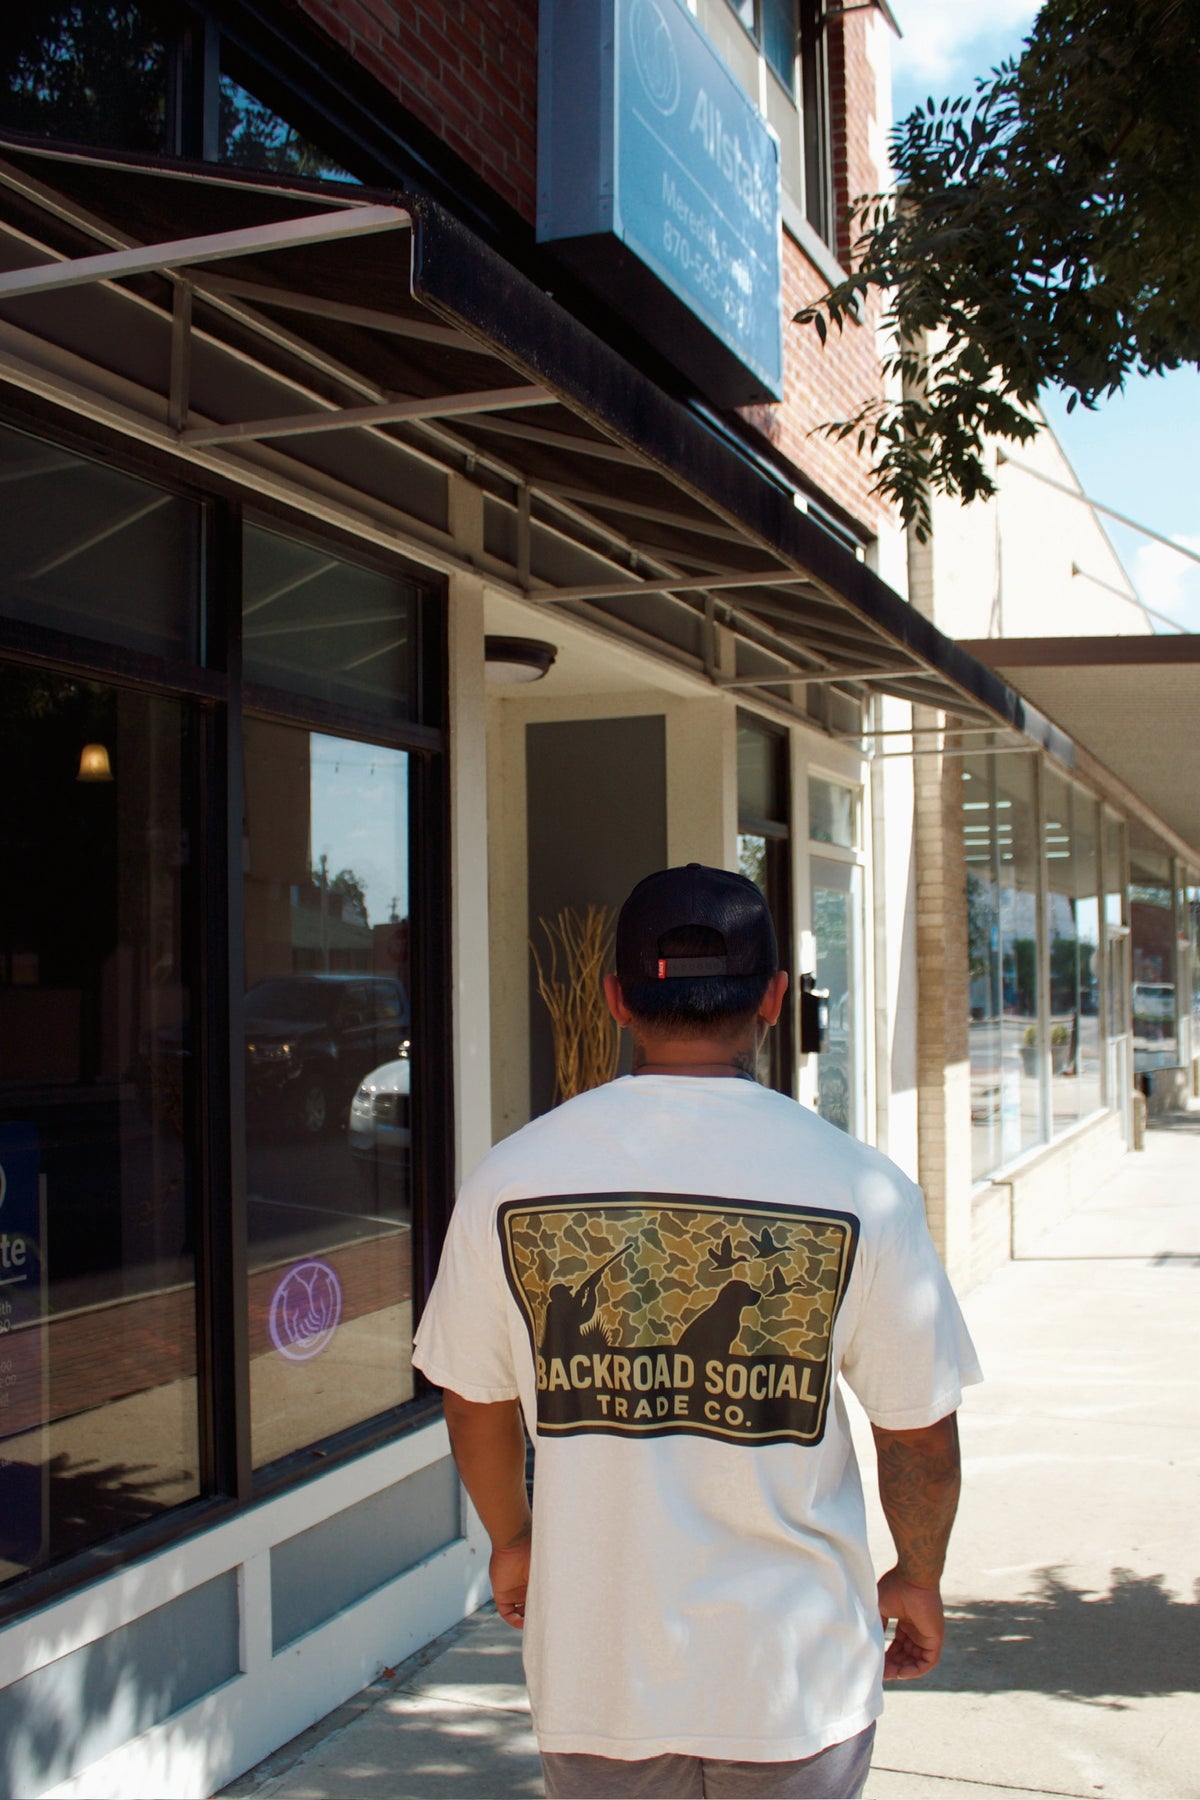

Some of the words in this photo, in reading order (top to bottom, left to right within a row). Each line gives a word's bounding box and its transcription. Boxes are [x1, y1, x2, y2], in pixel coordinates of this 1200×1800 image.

[689, 88, 773, 236] Allstate
[537, 1353, 695, 1391] BACKROAD
[704, 1360, 818, 1403] SOCIAL
[596, 1394, 689, 1419] TRADE
[704, 1400, 752, 1428] CO.
